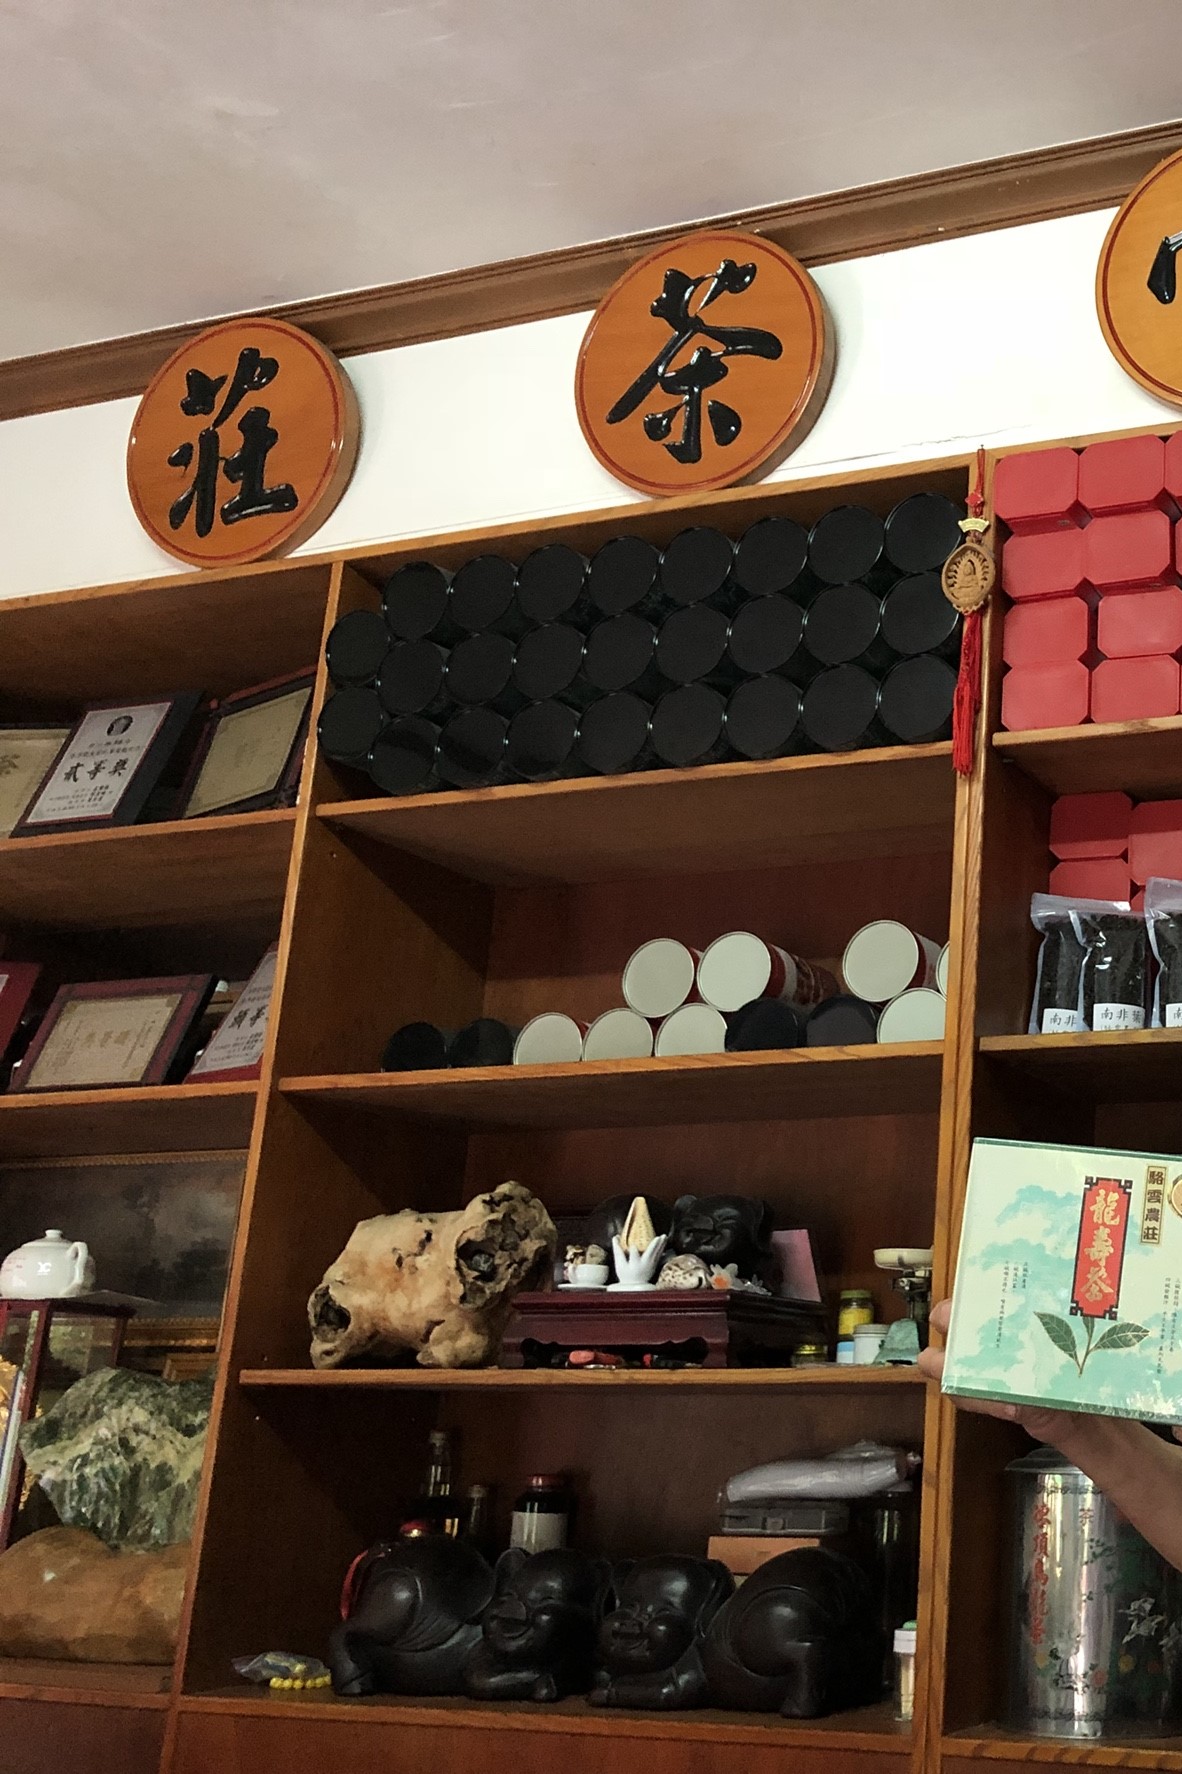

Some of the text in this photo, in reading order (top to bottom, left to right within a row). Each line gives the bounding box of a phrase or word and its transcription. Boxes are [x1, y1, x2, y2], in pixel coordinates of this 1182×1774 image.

[606, 259, 783, 464] 茶
[167, 347, 299, 538] 莊
[63, 758, 129, 783] 貳等獎
[1101, 1007, 1141, 1024] 南非葉
[1143, 1170, 1164, 1241] 駱雲農莊
